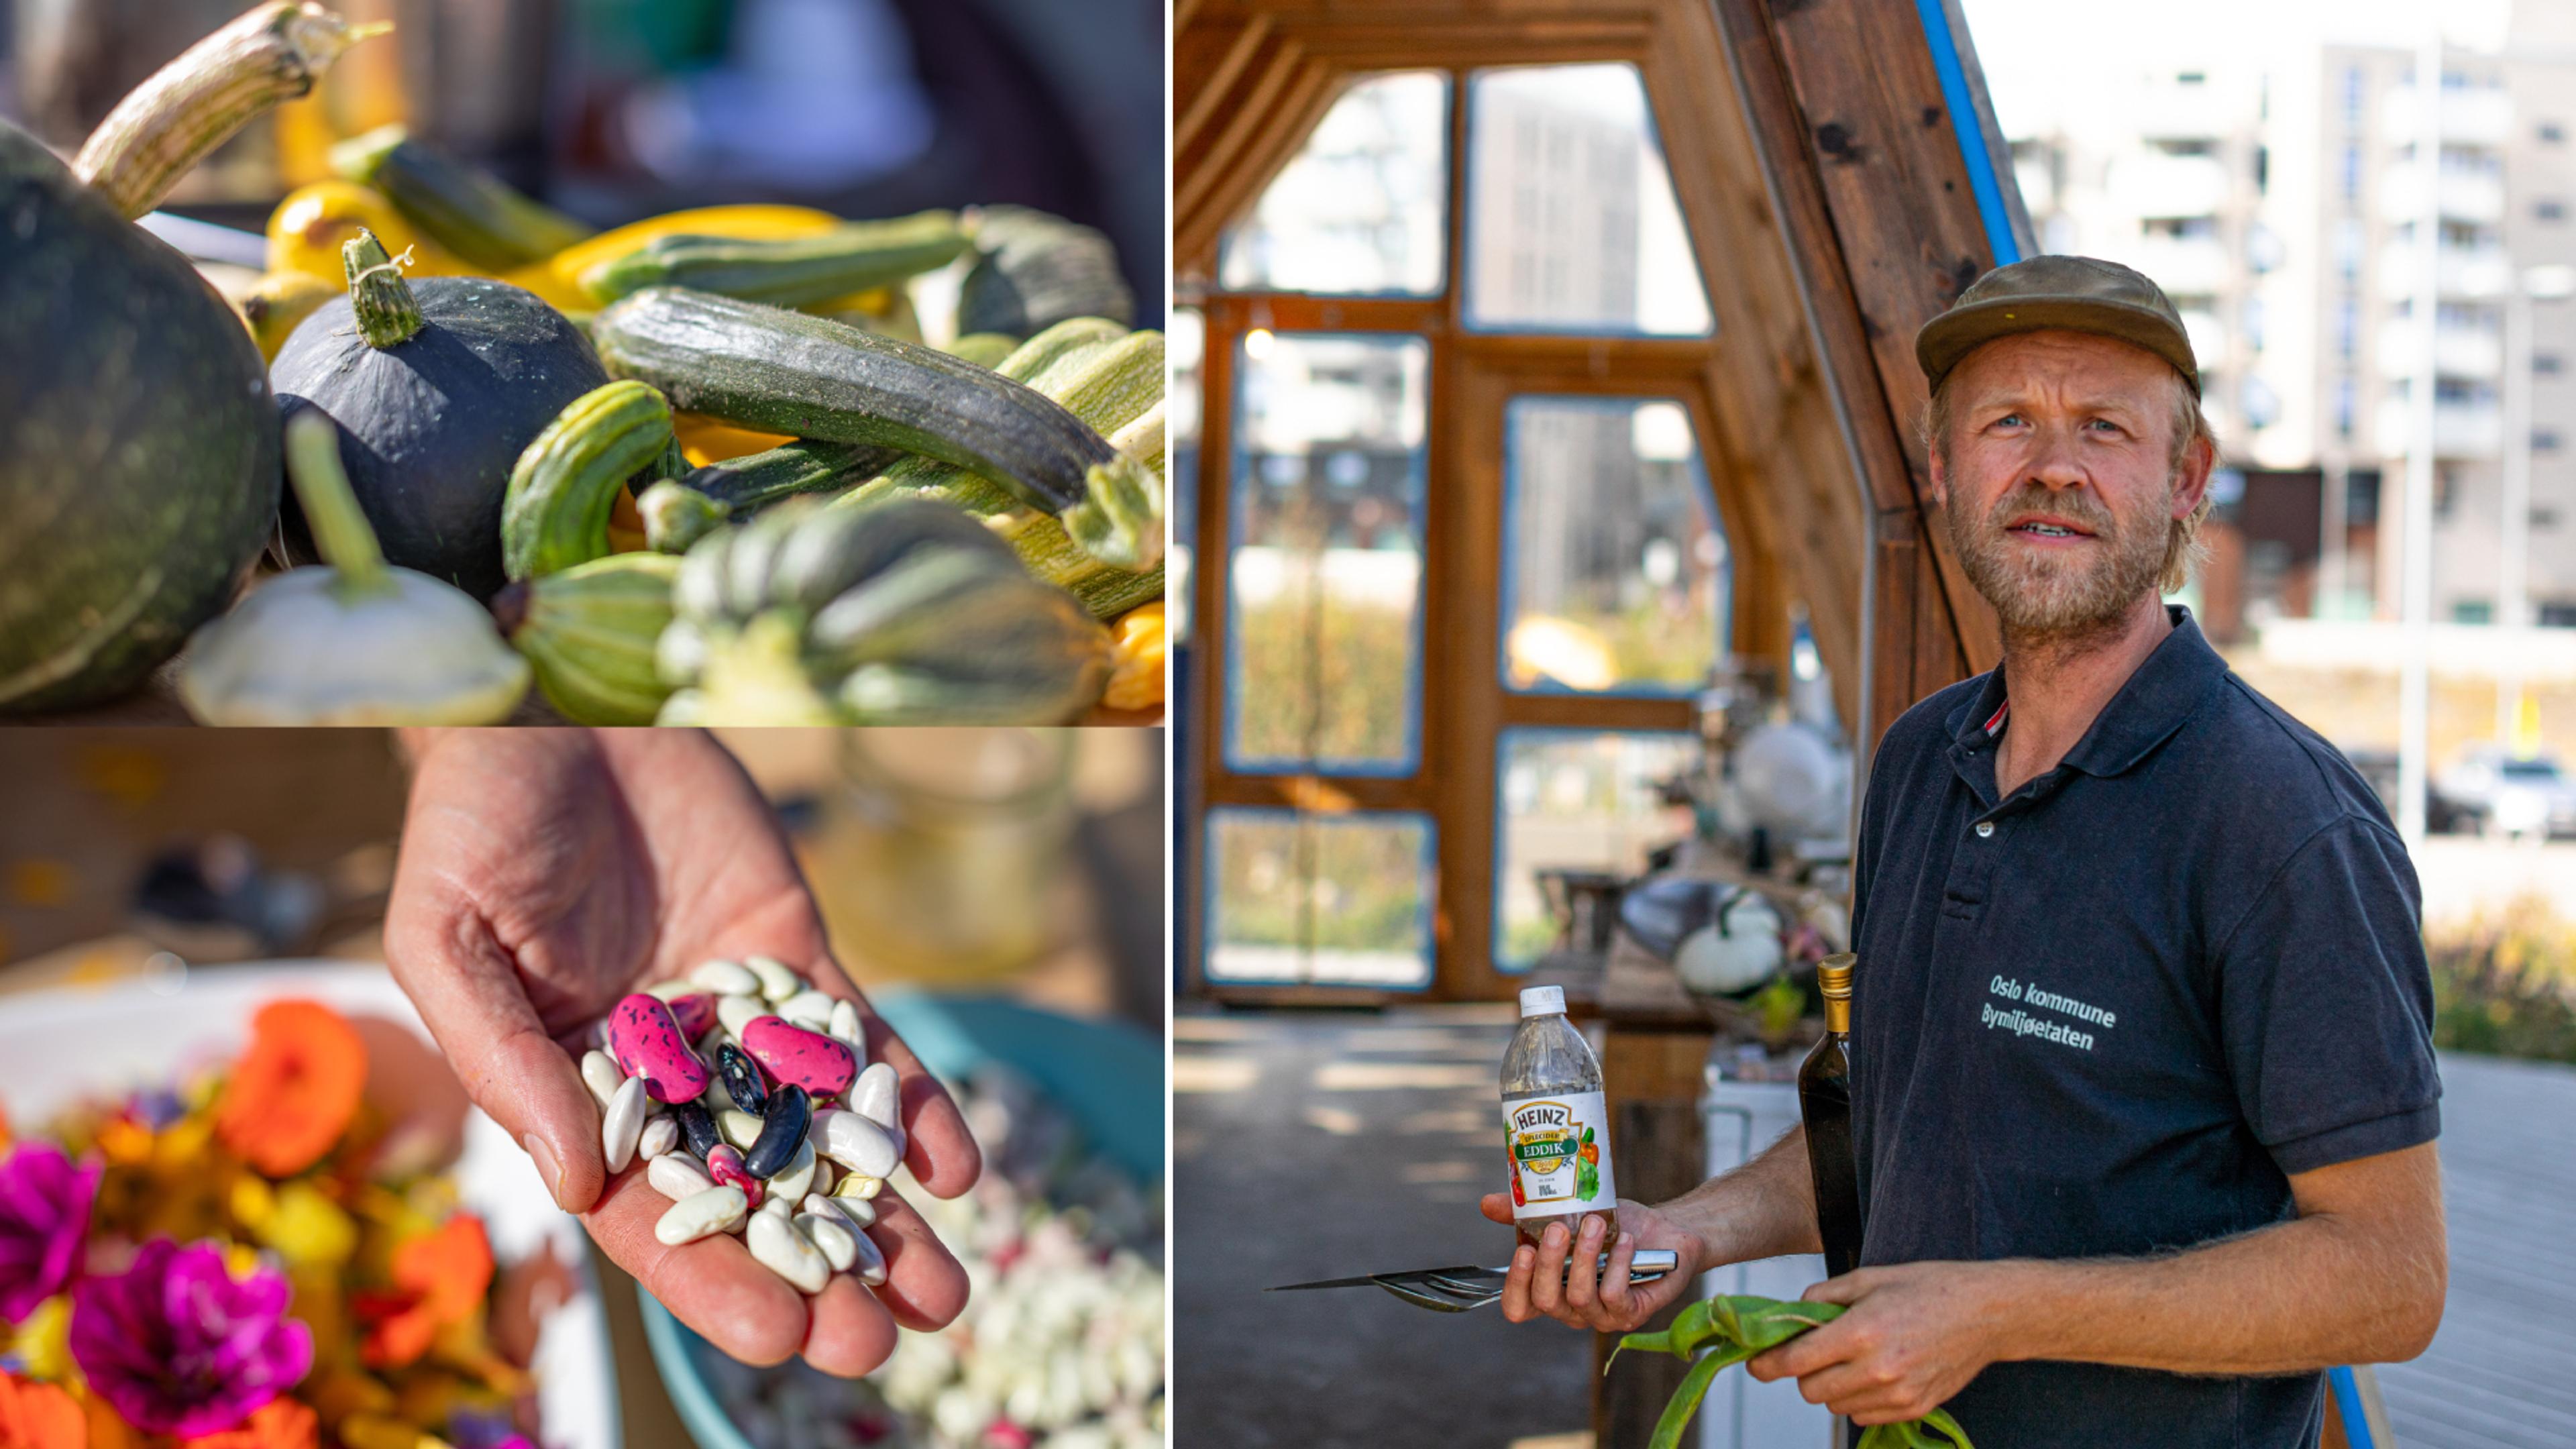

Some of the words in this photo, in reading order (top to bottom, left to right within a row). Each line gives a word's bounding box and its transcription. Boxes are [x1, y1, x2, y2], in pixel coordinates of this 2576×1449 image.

[1990, 975, 2022, 1000] Oslo
[2024, 982, 2116, 1028] kommune
[1981, 1003, 2094, 1051] Bymiljøetaten
[1517, 1108, 1565, 1130] HEINZ
[1523, 1142, 1565, 1157] EDDIK
